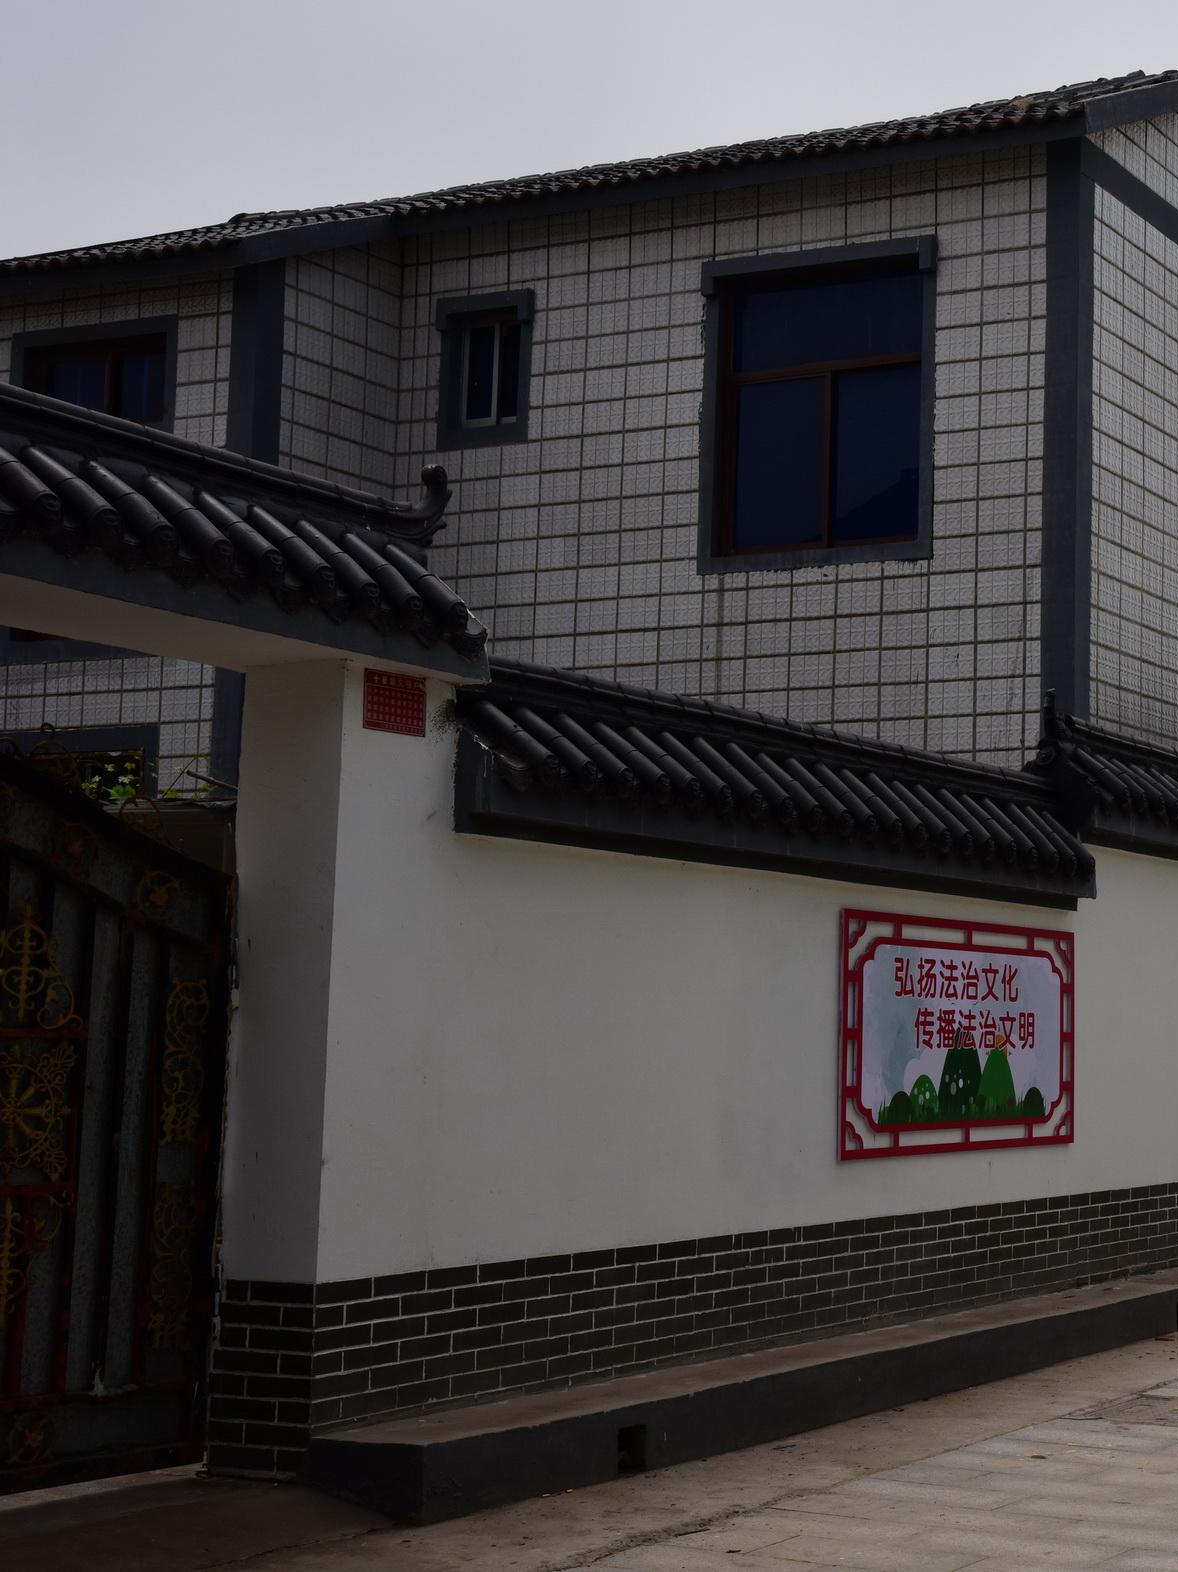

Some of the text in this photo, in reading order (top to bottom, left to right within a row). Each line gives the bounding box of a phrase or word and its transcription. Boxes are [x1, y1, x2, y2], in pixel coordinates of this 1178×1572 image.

[894, 956, 1019, 1003] 弘扬法治文化
[914, 1007, 1035, 1050] 传播法治文明
